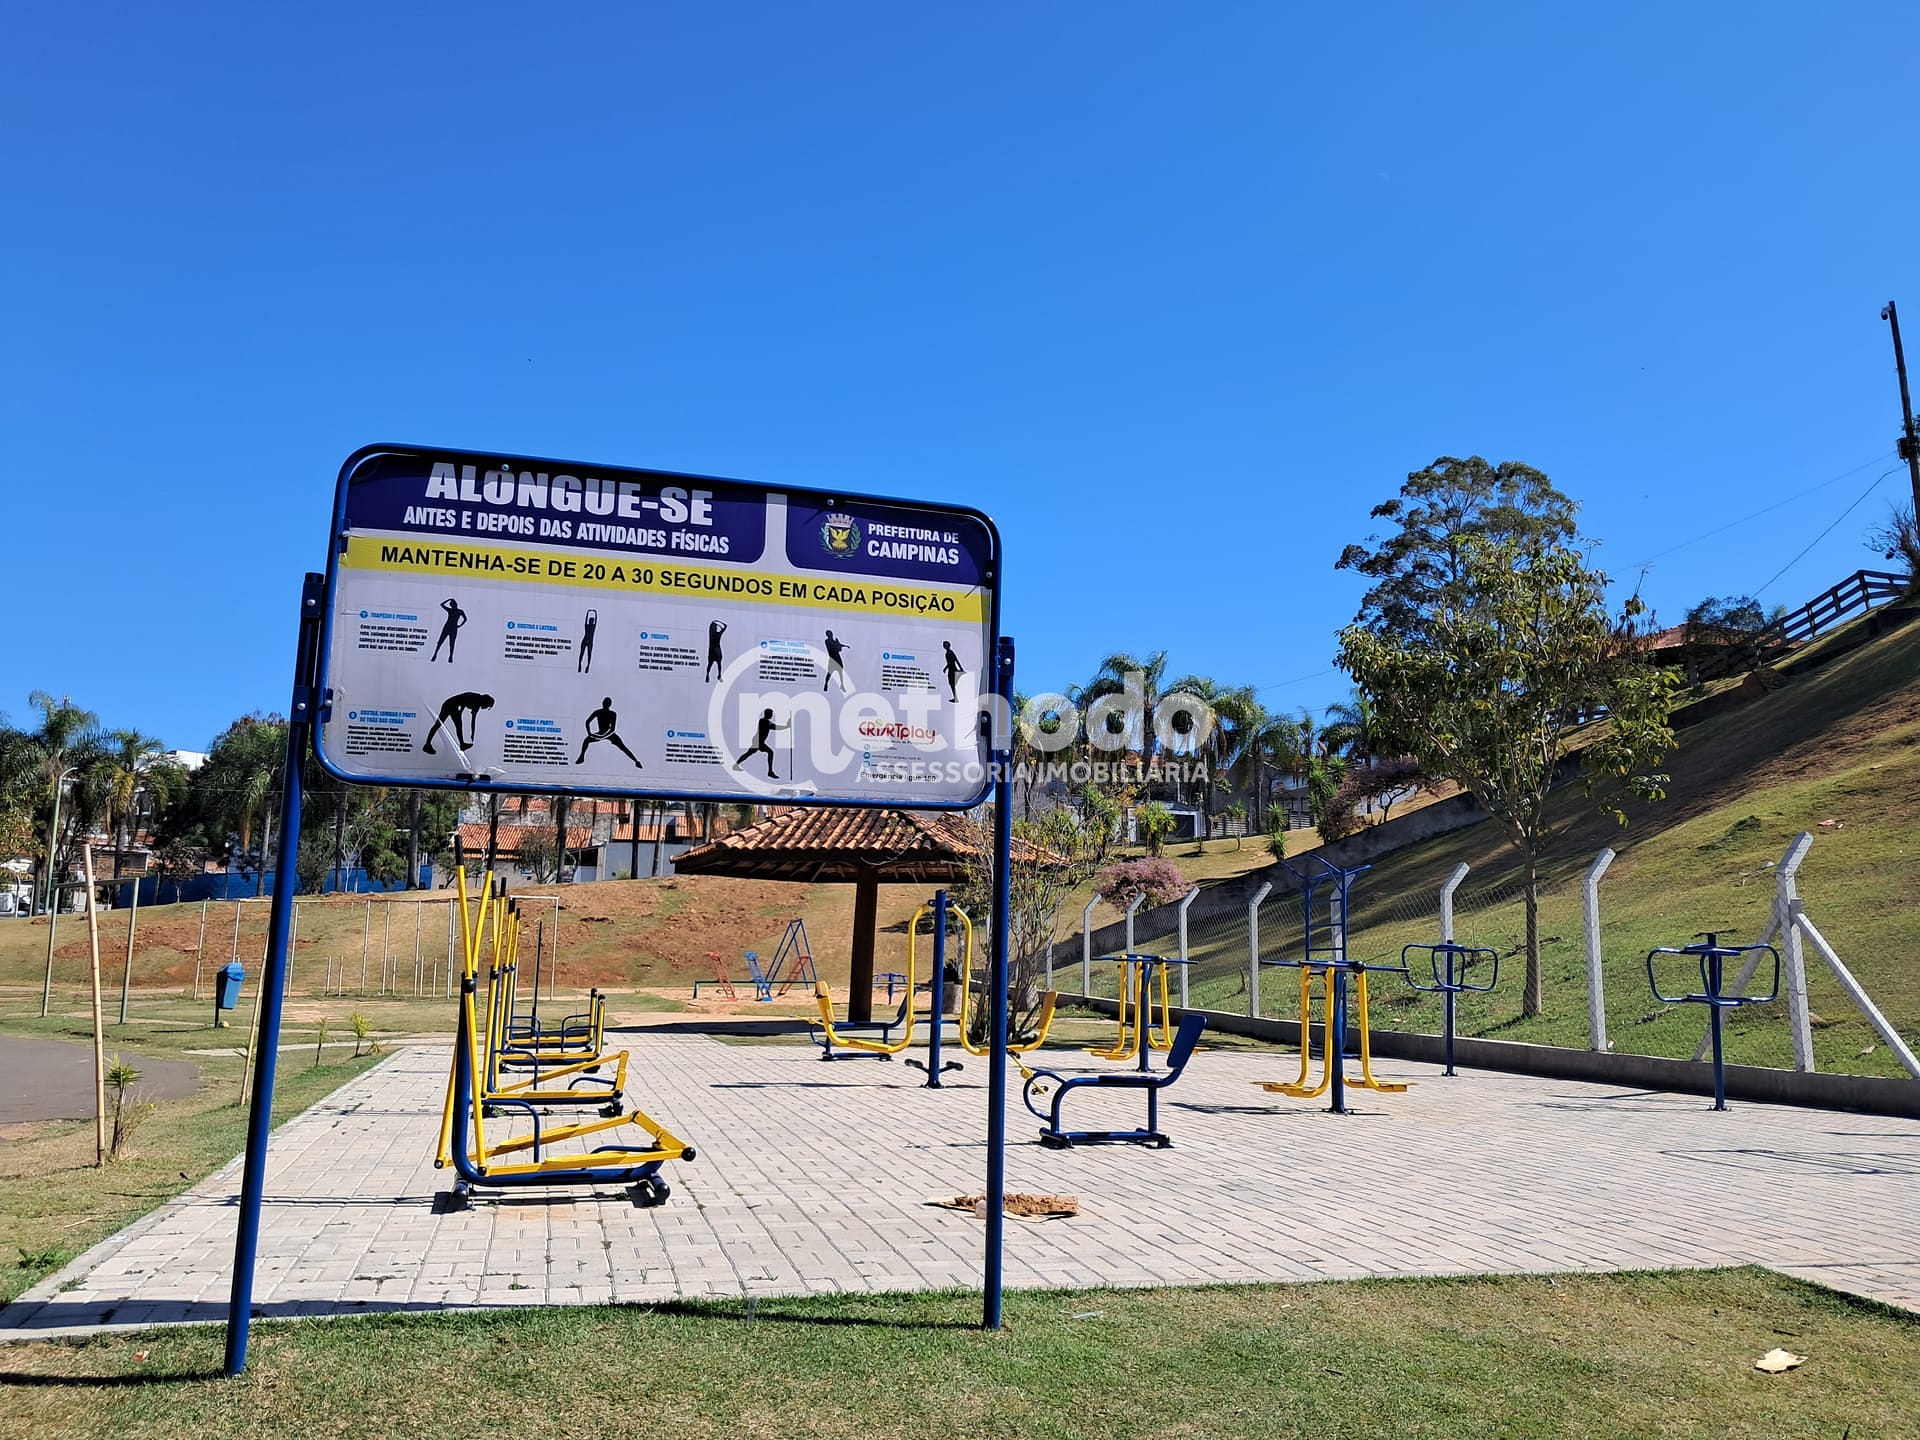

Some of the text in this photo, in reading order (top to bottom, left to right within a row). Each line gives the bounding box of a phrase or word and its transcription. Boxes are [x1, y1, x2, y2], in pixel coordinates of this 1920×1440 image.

[425, 462, 713, 526] ALONGUE-SE
[403, 505, 730, 554] ANTES E DEPOIS DAS ATIVIDADES FÍSICAS
[867, 540, 960, 565] CAMPINAS
[868, 523, 960, 544] PREFEITURA DE
[381, 546, 955, 613] MANTENHA-SE DE 20 A 30 SEGUNDOS EM CADA POSIÇÃO
